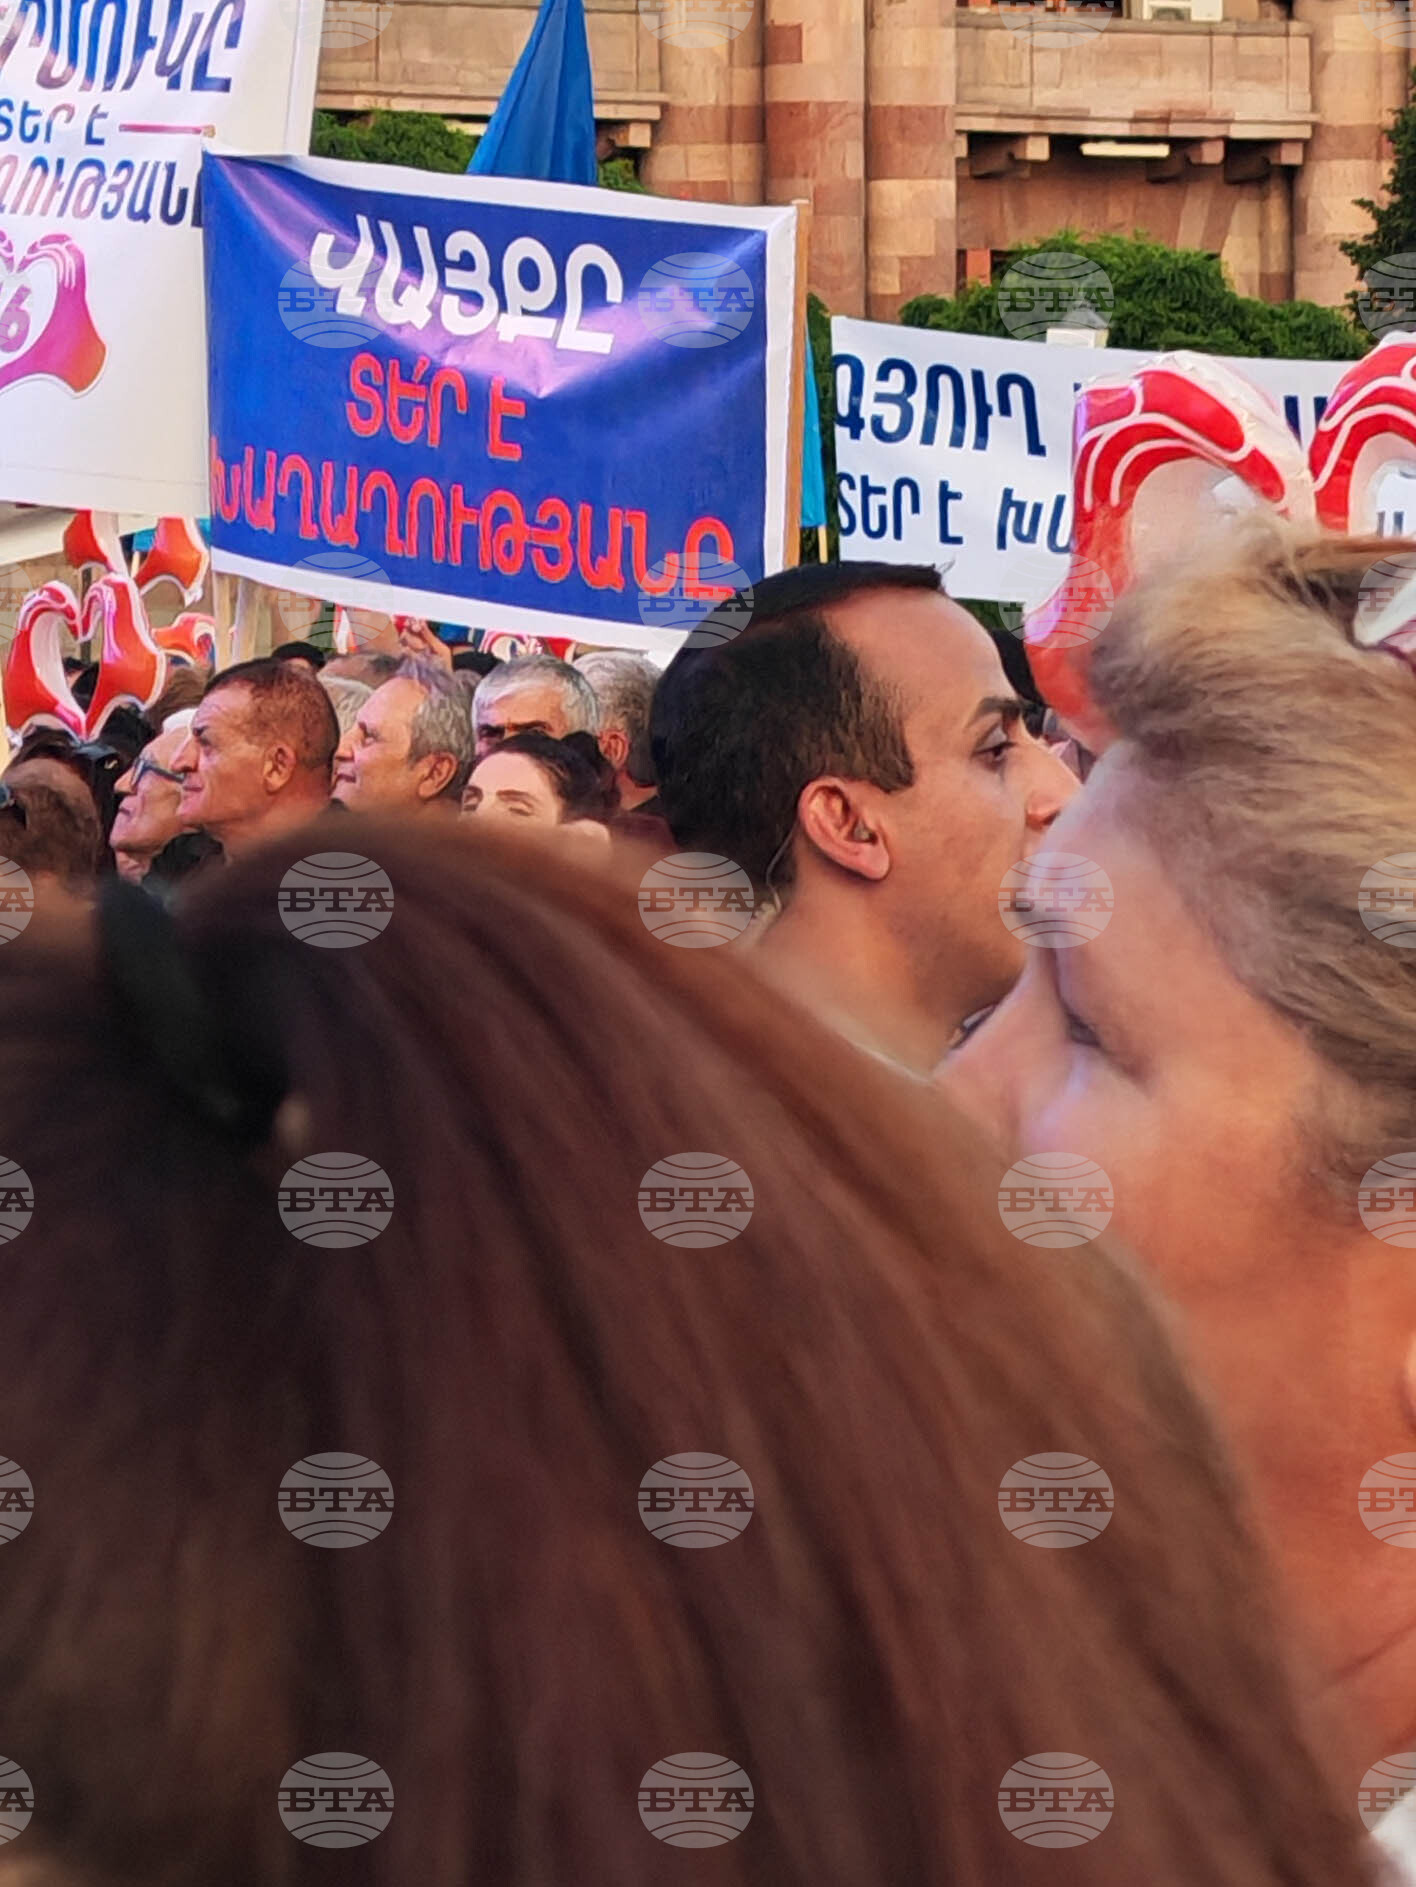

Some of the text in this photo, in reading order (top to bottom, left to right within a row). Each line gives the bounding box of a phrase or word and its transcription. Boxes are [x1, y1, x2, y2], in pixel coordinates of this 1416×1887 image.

[84, 103, 110, 146] Է
[309, 213, 624, 355] ՎԱՅՔԸ
[487, 374, 528, 463] Է
[837, 471, 921, 541] ՏԵՐ
[938, 479, 964, 545] Է
